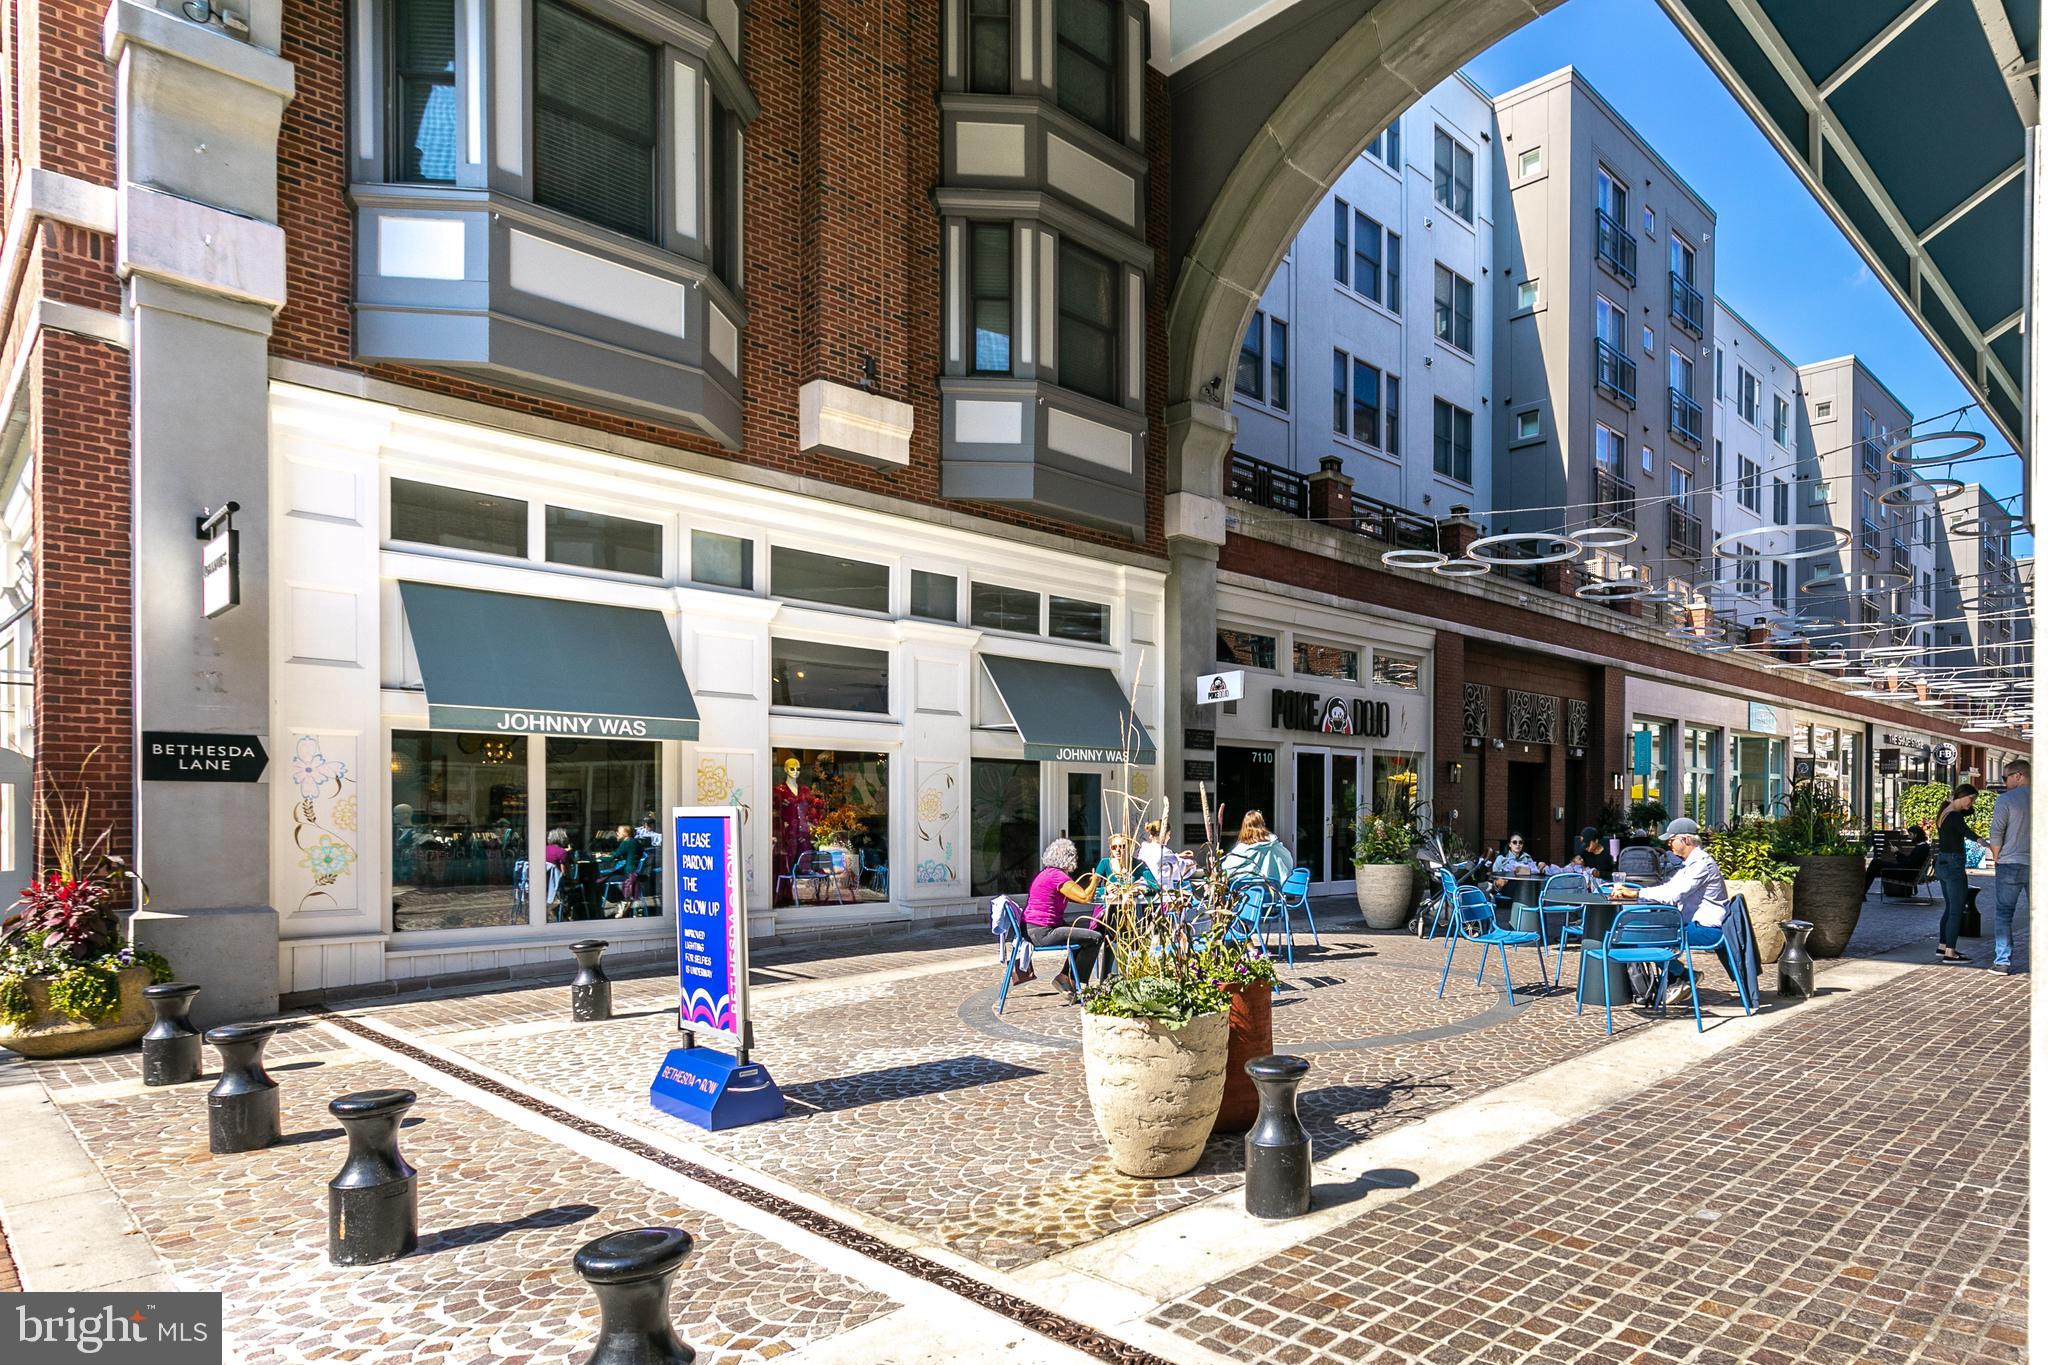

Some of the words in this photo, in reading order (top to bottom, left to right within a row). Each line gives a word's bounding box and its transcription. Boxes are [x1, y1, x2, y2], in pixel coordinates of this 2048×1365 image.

[1271, 688, 1320, 731] POKE
[1353, 699, 1390, 738] DOJO
[497, 712, 593, 733] JOHNNY
[598, 718, 647, 736] WAS
[152, 743, 256, 758] BETHESDA
[1056, 747, 1102, 761] JOHNNY
[1106, 750, 1129, 763] WAS
[1252, 751, 1273, 764] 7110
[179, 758, 231, 771] LANE
[682, 832, 711, 848] PLEASE
[682, 854, 713, 871] PARDON
[682, 876, 698, 892] THE
[683, 898, 706, 915] GLOW
[708, 901, 720, 917] UP
[662, 1066, 695, 1087] BETHESDA
[699, 1078, 719, 1094] ROW
